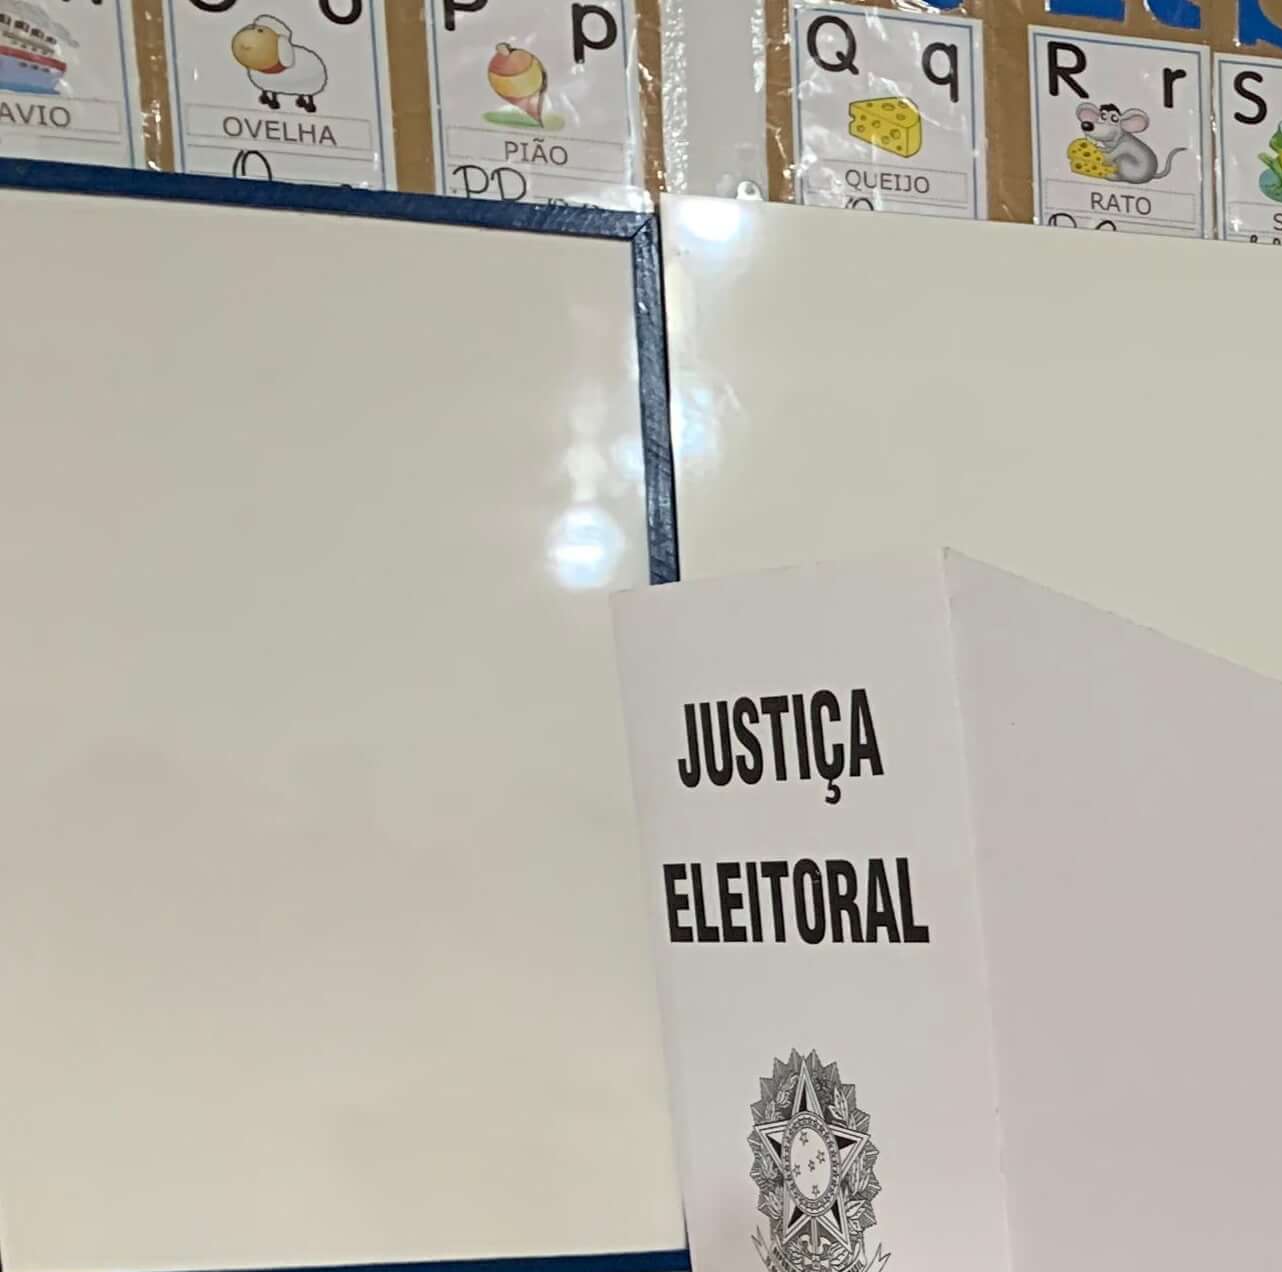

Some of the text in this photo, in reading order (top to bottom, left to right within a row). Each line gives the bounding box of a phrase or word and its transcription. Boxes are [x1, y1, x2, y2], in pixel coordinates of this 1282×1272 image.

[572, 3, 617, 64] p
[807, 15, 959, 103] Q q
[1047, 41, 1186, 108] R r
[1234, 71, 1267, 125] S
[223, 116, 337, 146] OVELHA
[505, 138, 568, 165] PIÃO
[845, 169, 930, 194] QUEIJO
[1090, 191, 1151, 216] RATO
[677, 688, 884, 805] JUSTIÇA
[663, 857, 930, 945] ELEITORAL
